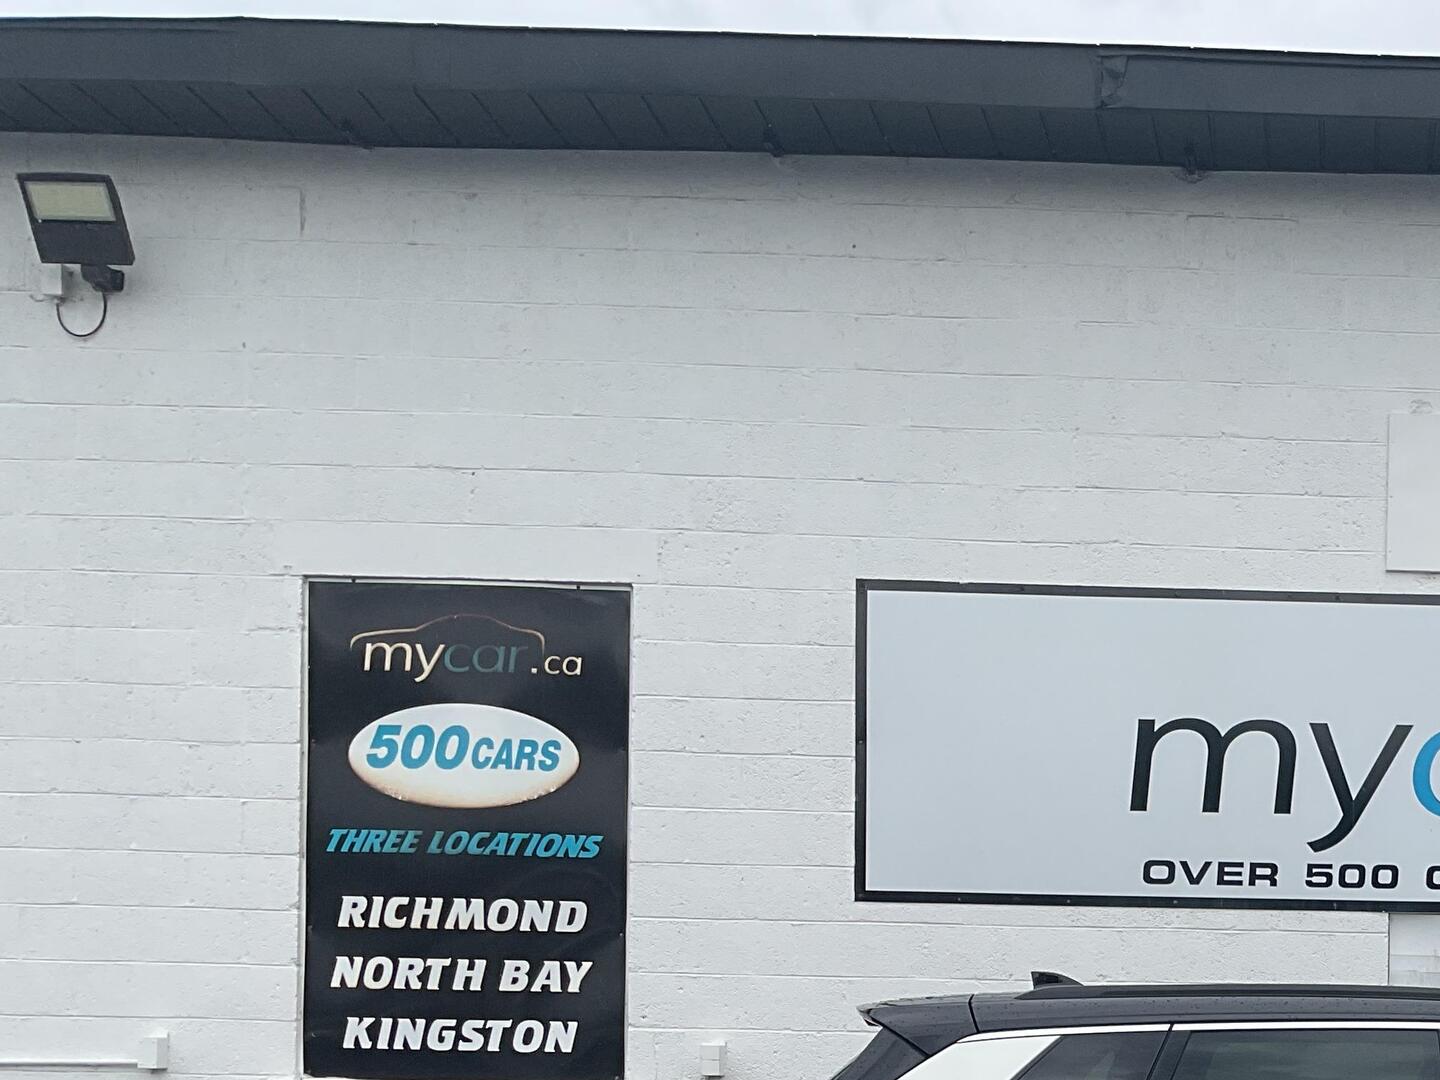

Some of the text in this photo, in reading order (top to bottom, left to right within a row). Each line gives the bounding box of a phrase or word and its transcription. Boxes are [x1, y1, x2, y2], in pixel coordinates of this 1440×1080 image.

[366, 725, 562, 772] 500 CARS
[326, 828, 603, 859] THREE LOCATIONS
[1142, 859, 1279, 887] OVER
[1305, 863, 1399, 889] 500
[337, 895, 587, 933] RICHMOND
[330, 956, 593, 993] NORTH BAY
[342, 1016, 579, 1053] KINGSTON
